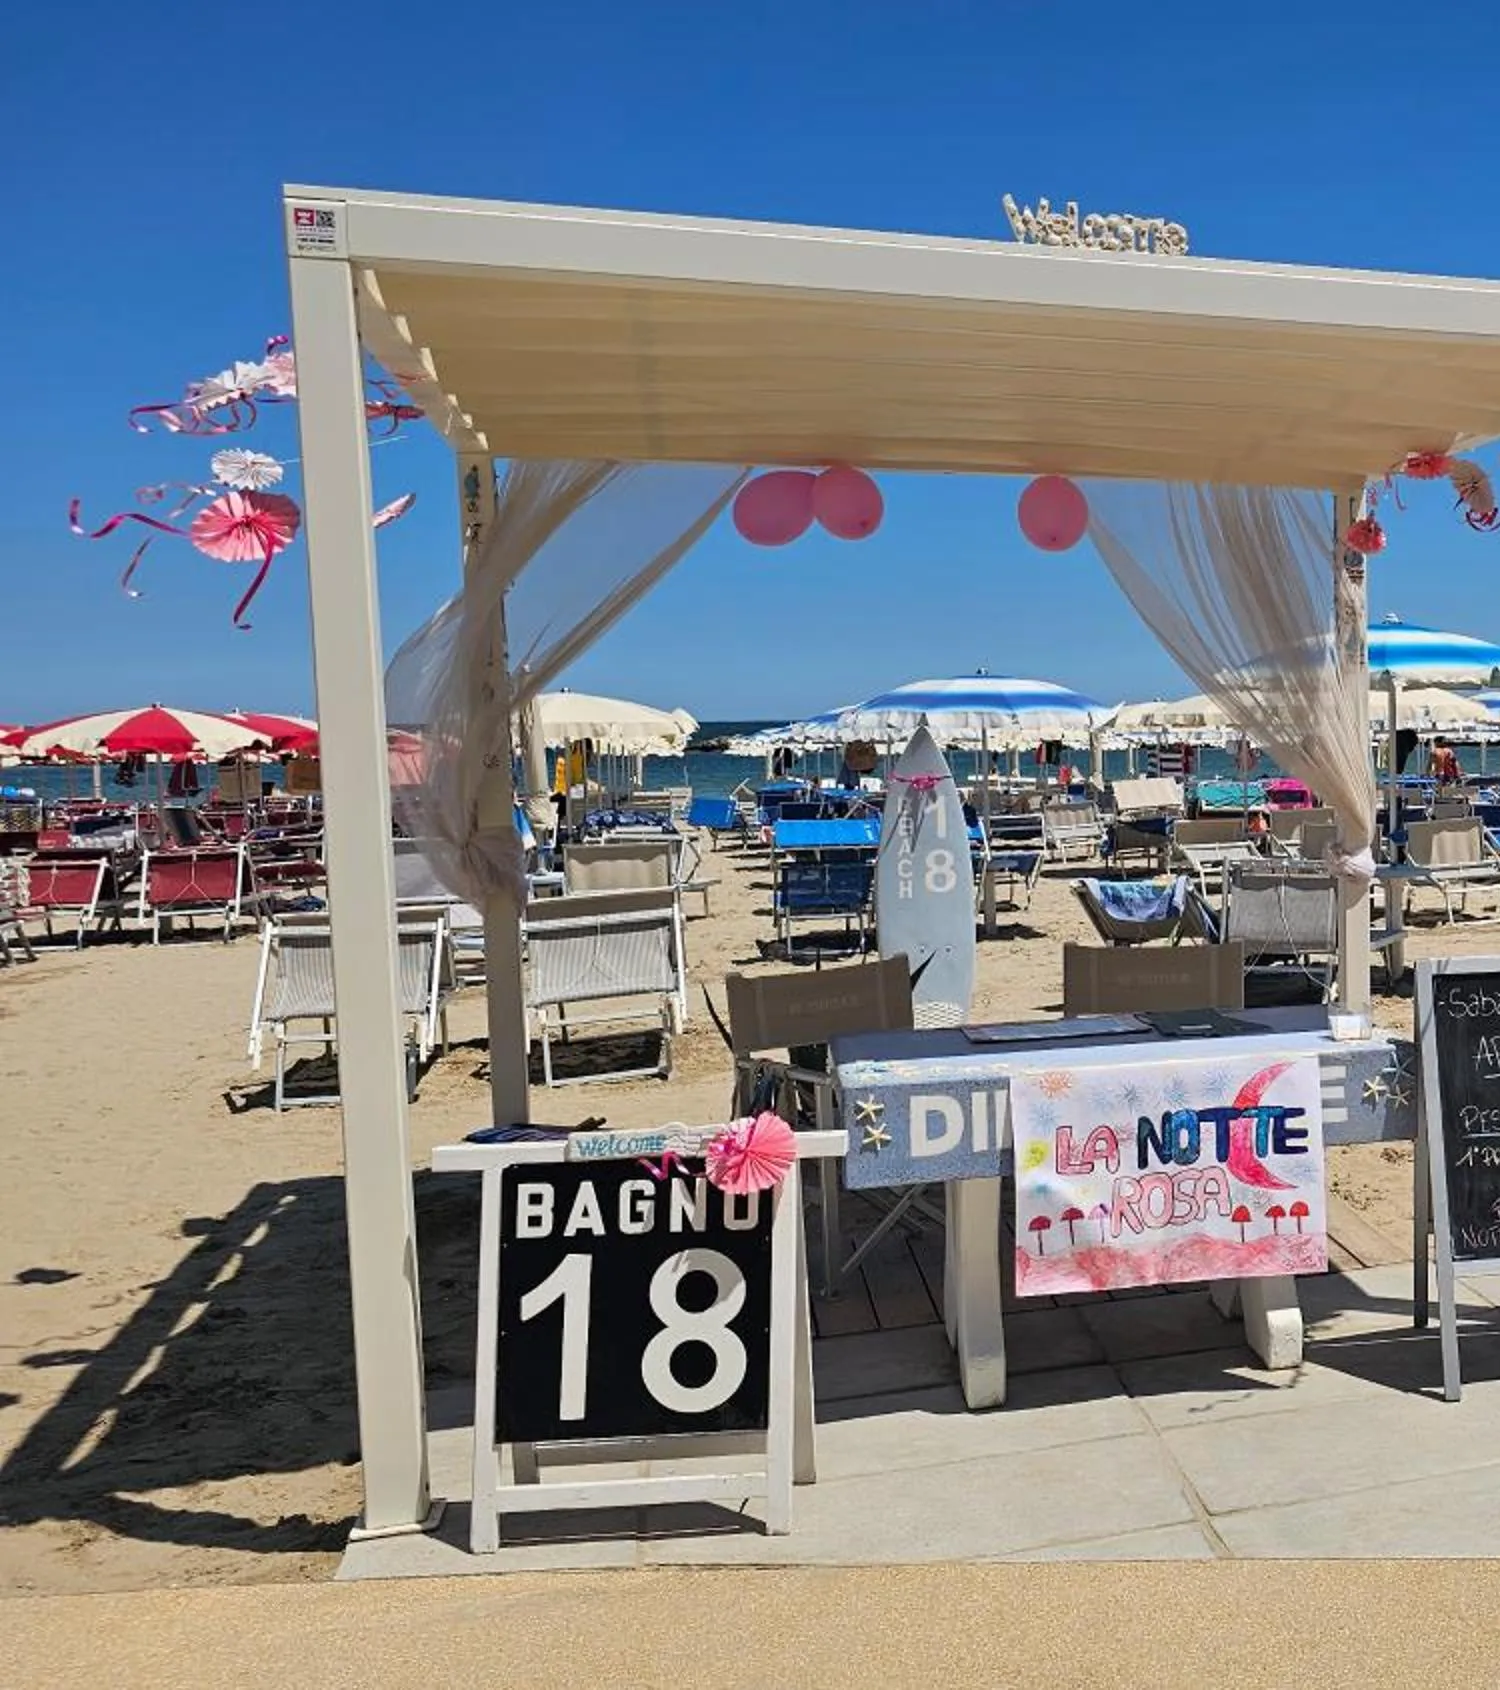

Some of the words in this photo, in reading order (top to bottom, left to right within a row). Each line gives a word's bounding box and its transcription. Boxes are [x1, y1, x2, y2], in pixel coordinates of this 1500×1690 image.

[1002, 193, 1188, 256] Welcome
[924, 796, 957, 893] 18
[576, 1134, 667, 1157] welcome
[1055, 1124, 1121, 1175] LA
[1137, 1105, 1309, 1170] NOTTE
[515, 1177, 760, 1239] BAGNO
[1109, 1167, 1233, 1238] ROSA
[520, 1247, 748, 1422] 18
